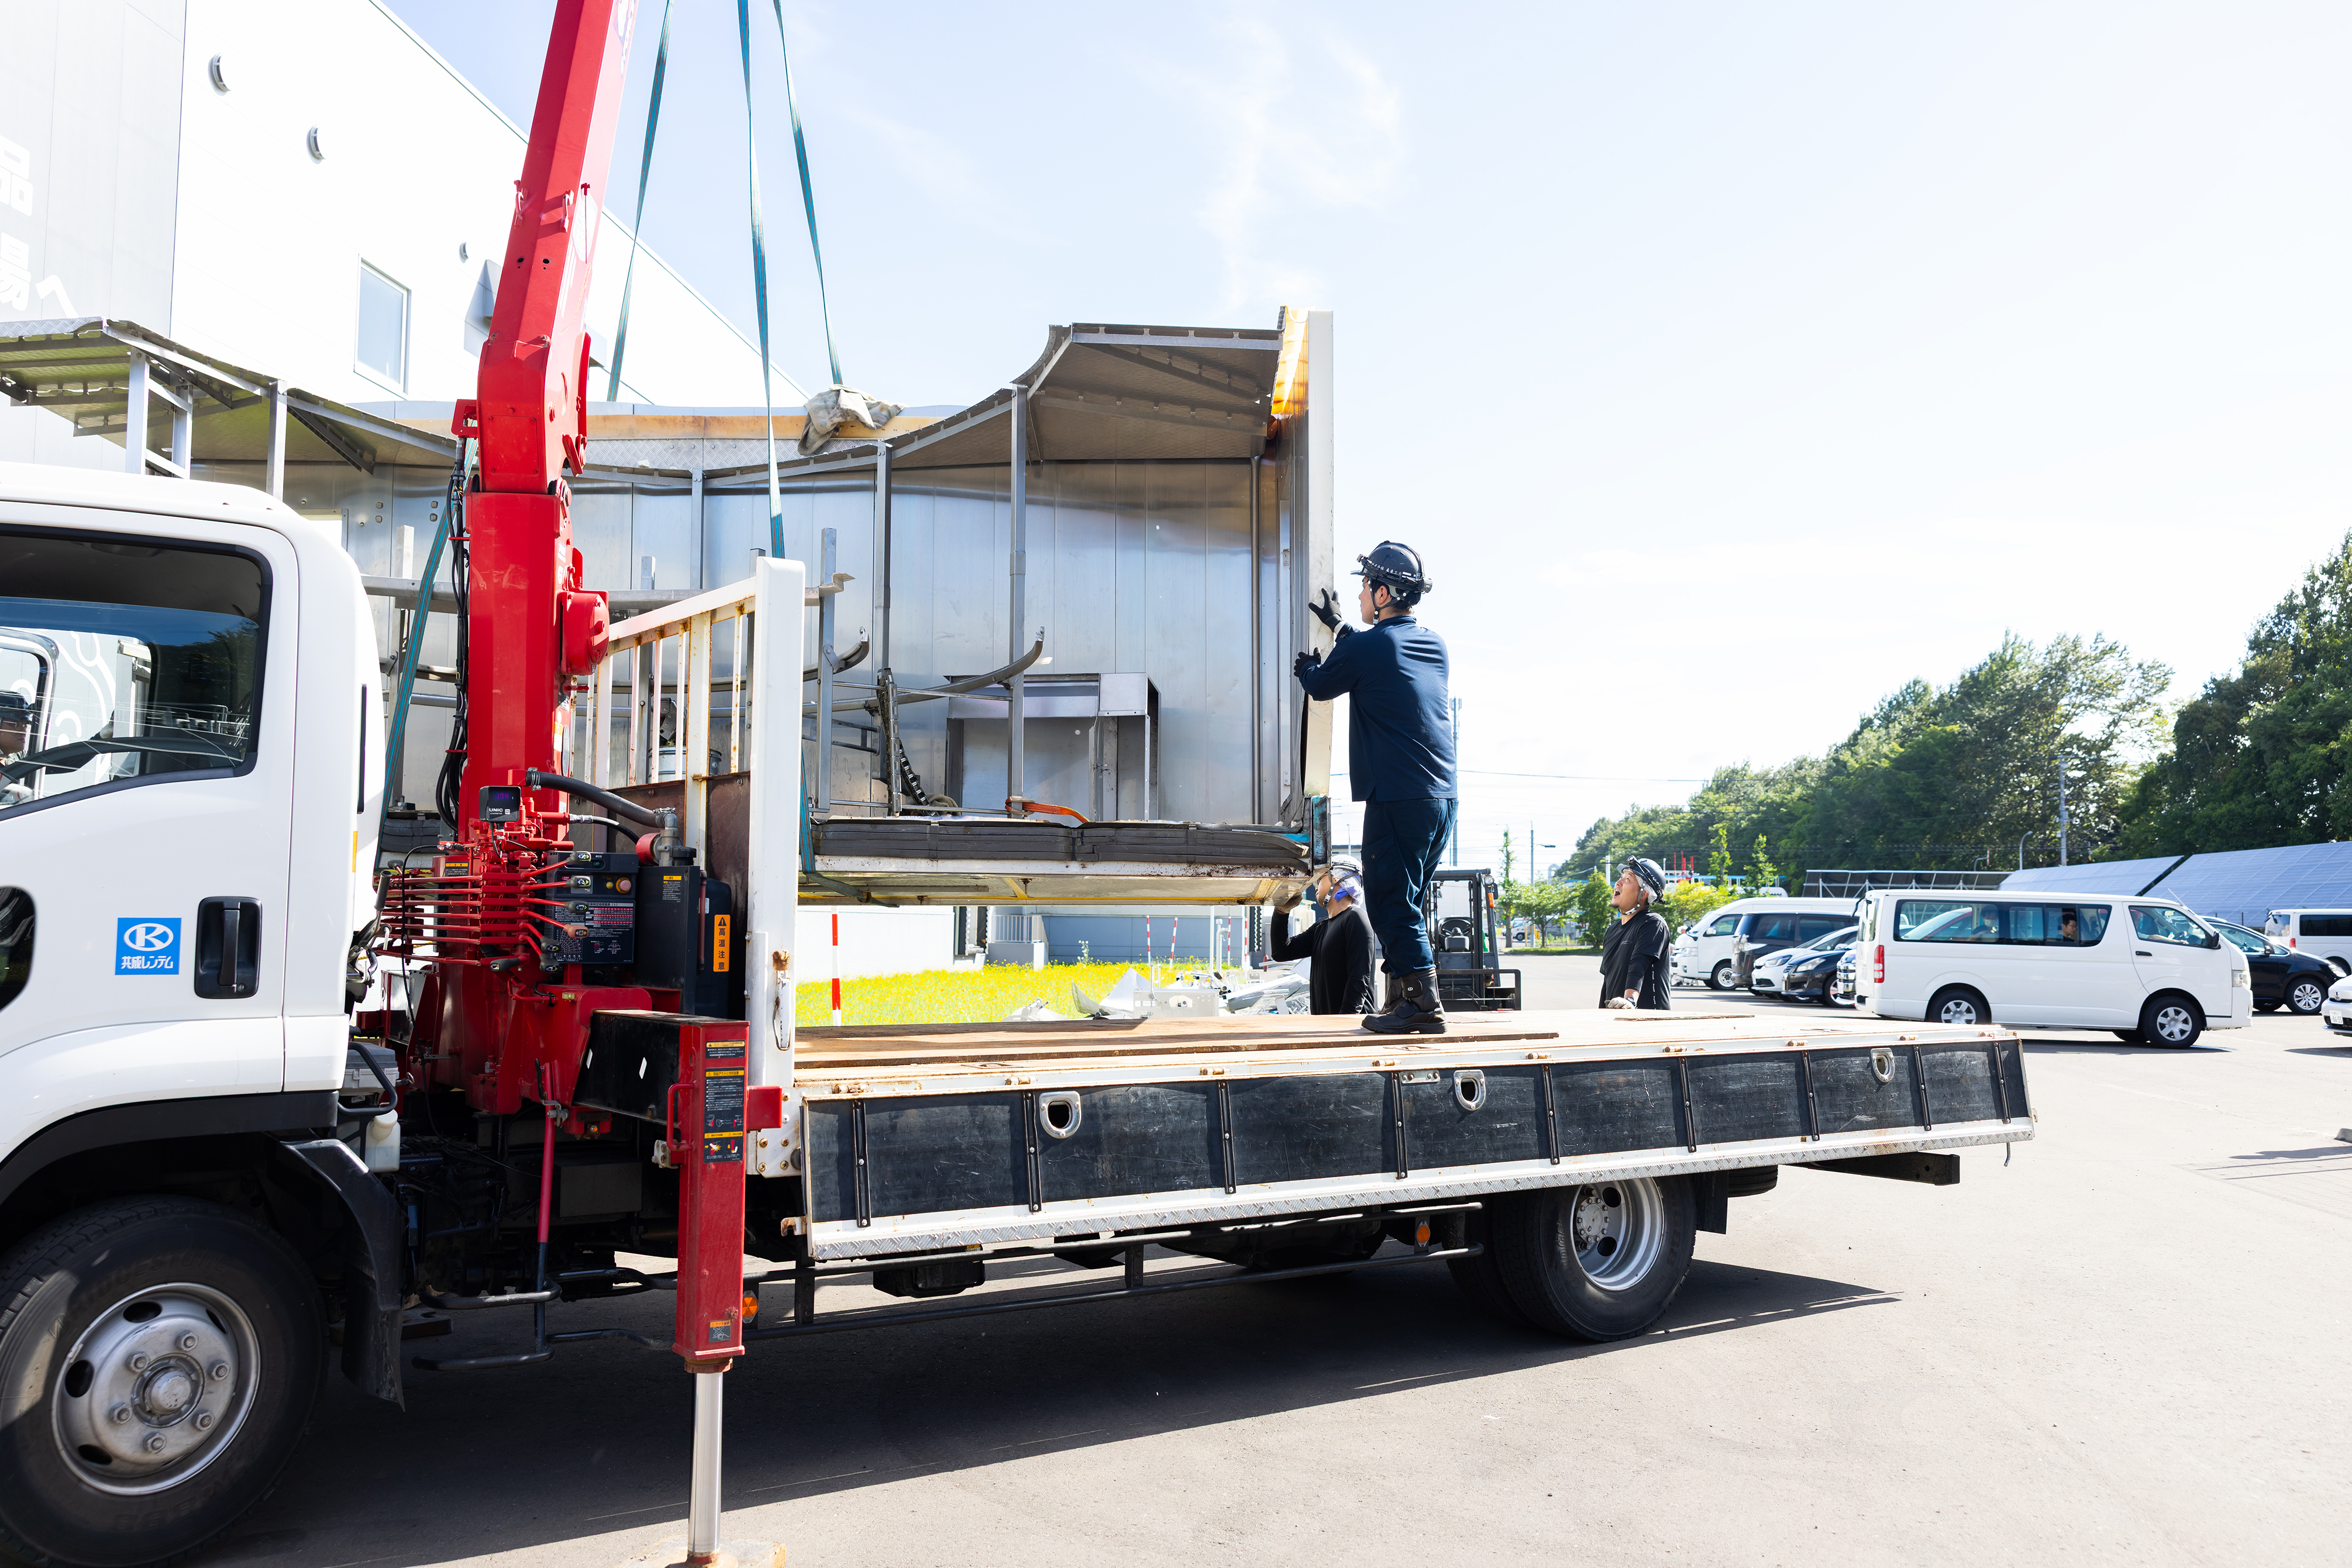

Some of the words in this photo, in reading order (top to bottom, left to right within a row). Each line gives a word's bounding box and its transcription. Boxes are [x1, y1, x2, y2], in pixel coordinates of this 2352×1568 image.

[120, 955, 174, 969] 共成レンテム
[718, 928, 726, 970] 高温注意
